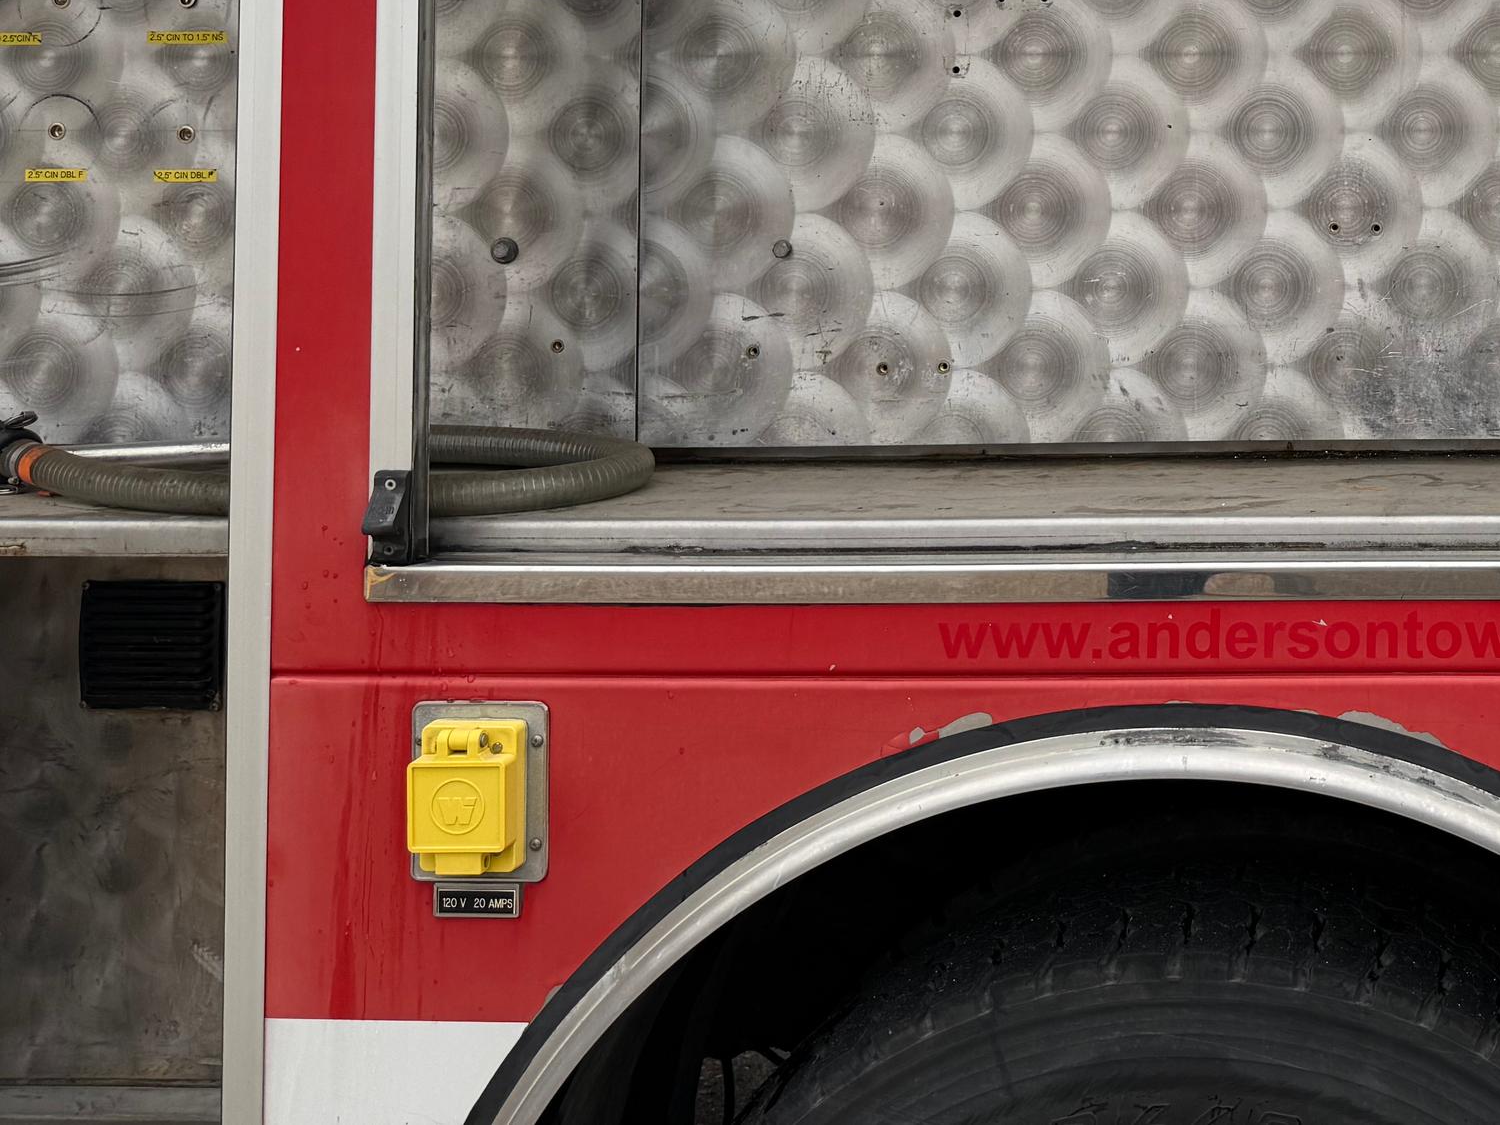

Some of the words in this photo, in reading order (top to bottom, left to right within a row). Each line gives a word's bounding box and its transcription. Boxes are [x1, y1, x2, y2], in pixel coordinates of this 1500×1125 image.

[150, 33, 164, 41] 2.5"
[166, 33, 180, 41] CIN
[181, 33, 194, 41] TO
[212, 33, 224, 41] NS
[28, 170, 43, 179] 2.5"
[44, 170, 59, 179] CIN
[60, 170, 76, 179] DBL
[78, 170, 84, 179] F
[174, 171, 188, 179] CIN
[190, 171, 207, 179] DBL
[443, 897, 457, 908] 120
[459, 898, 466, 908] V
[473, 898, 486, 909] 20
[488, 898, 513, 909] AMPS
